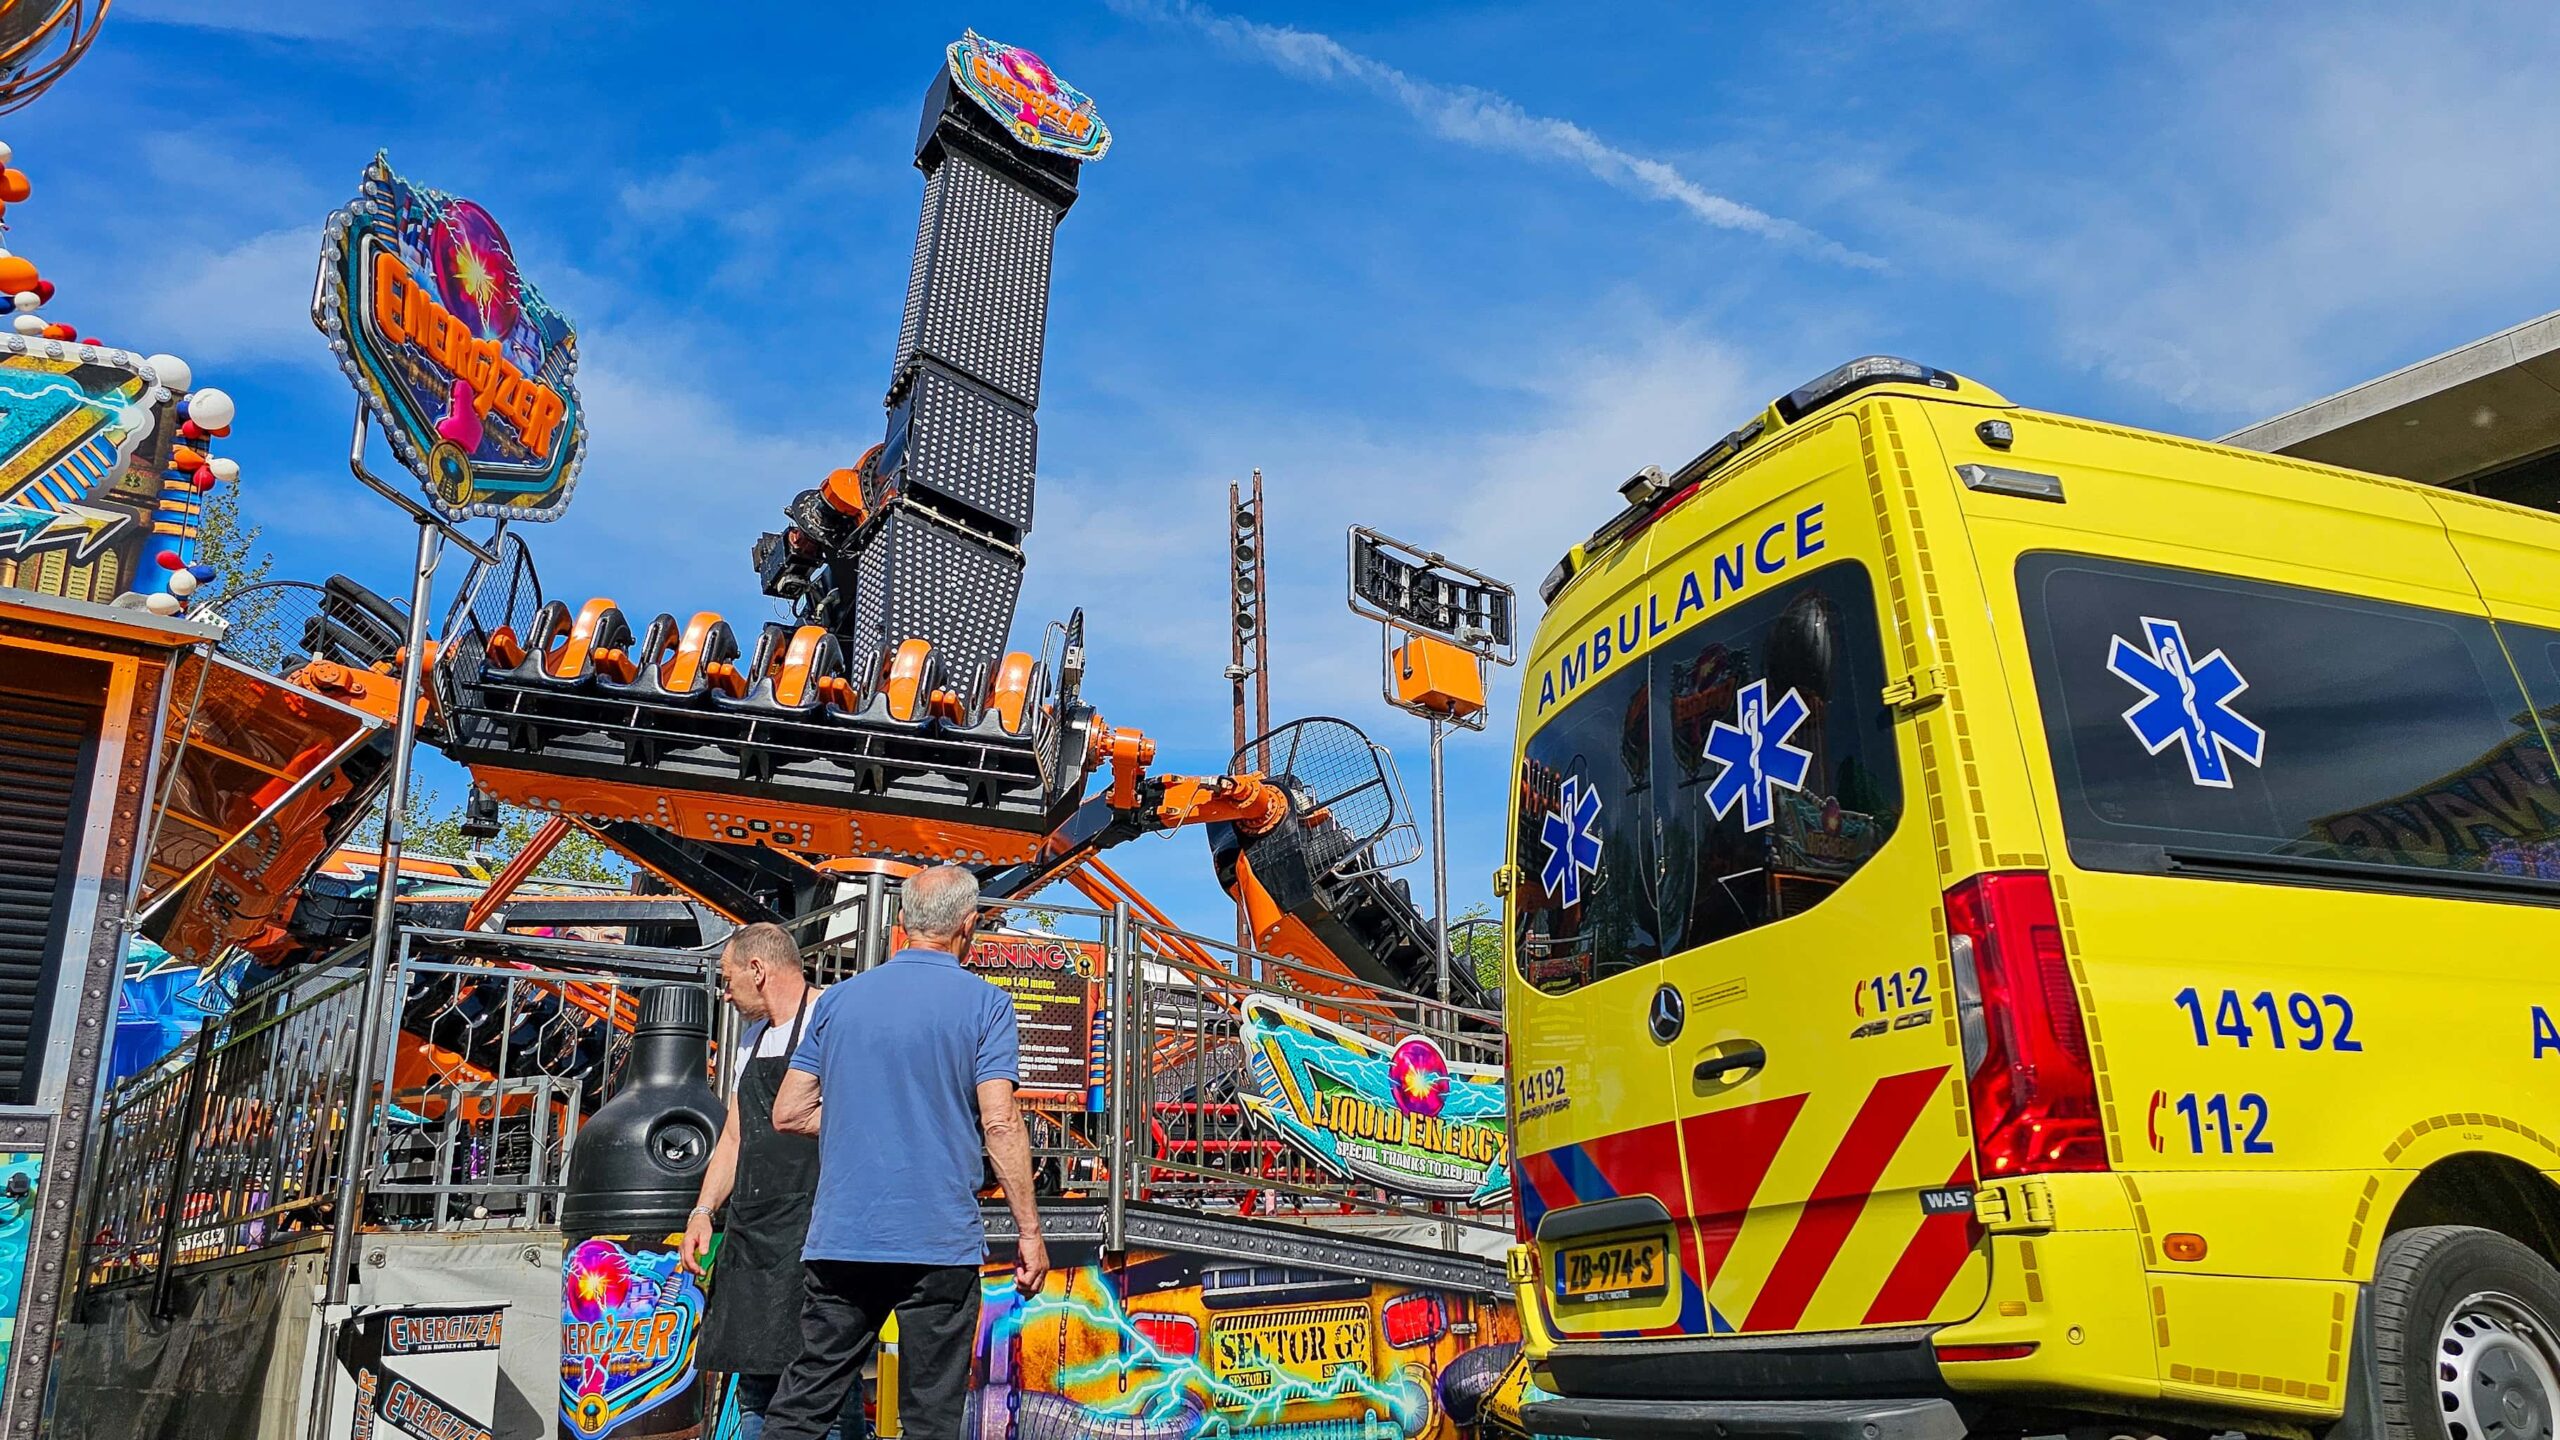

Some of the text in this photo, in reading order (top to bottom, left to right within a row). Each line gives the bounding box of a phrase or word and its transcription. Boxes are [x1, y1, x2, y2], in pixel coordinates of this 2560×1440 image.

[973, 56, 1091, 139] ENERGIZER
[376, 251, 564, 459] ENERGIZER
[1537, 501, 1826, 718] AMBULANCE
[959, 941, 1067, 970] ARNING
[2173, 987, 2364, 1052] 14192
[1518, 1065, 1566, 1107] 14192
[1312, 1090, 1509, 1166] LIQUID ENERGY
[1335, 1140, 1489, 1186] SPECIAL THANKS TO RED BULL
[562, 1310, 680, 1359] NERGIZER
[1220, 1326, 1328, 1371] SECTOR
[1229, 1373, 1262, 1387] SECTOR
